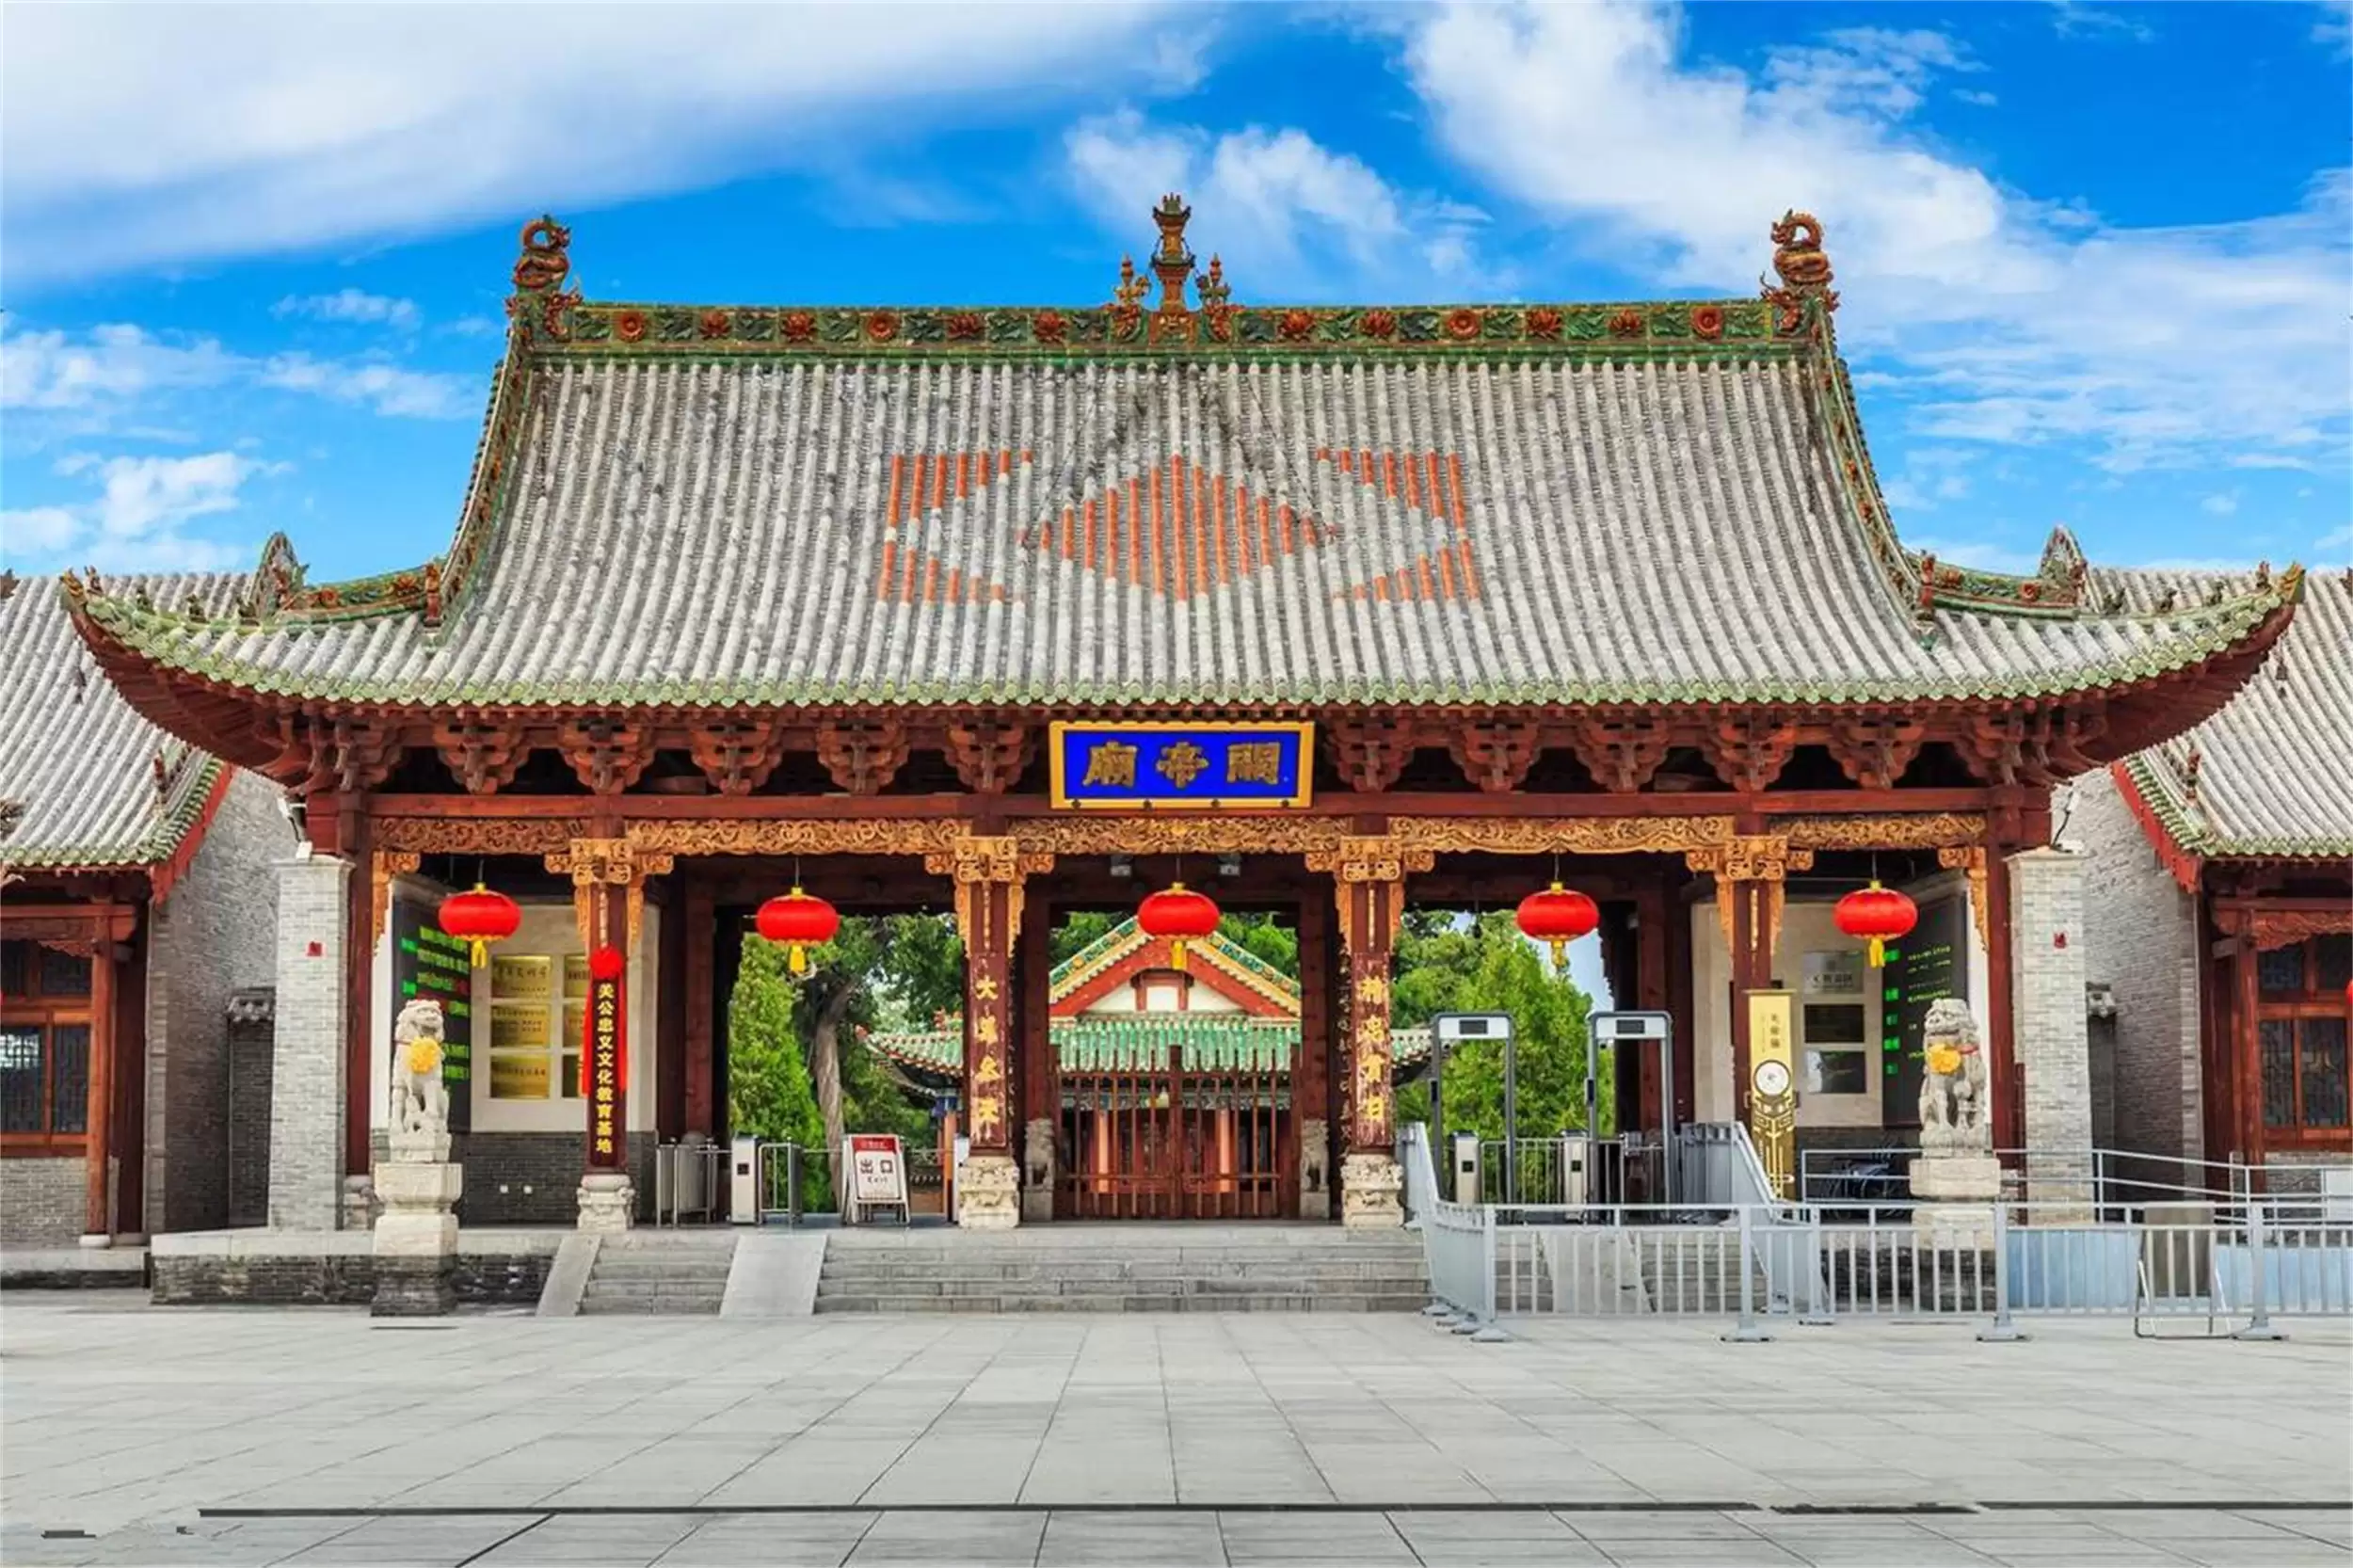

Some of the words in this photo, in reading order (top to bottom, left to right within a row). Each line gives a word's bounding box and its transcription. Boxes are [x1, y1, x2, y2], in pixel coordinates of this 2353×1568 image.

[597, 983, 615, 1153] 关公忠义文化教育基地
[860, 1159, 893, 1174] 出口
